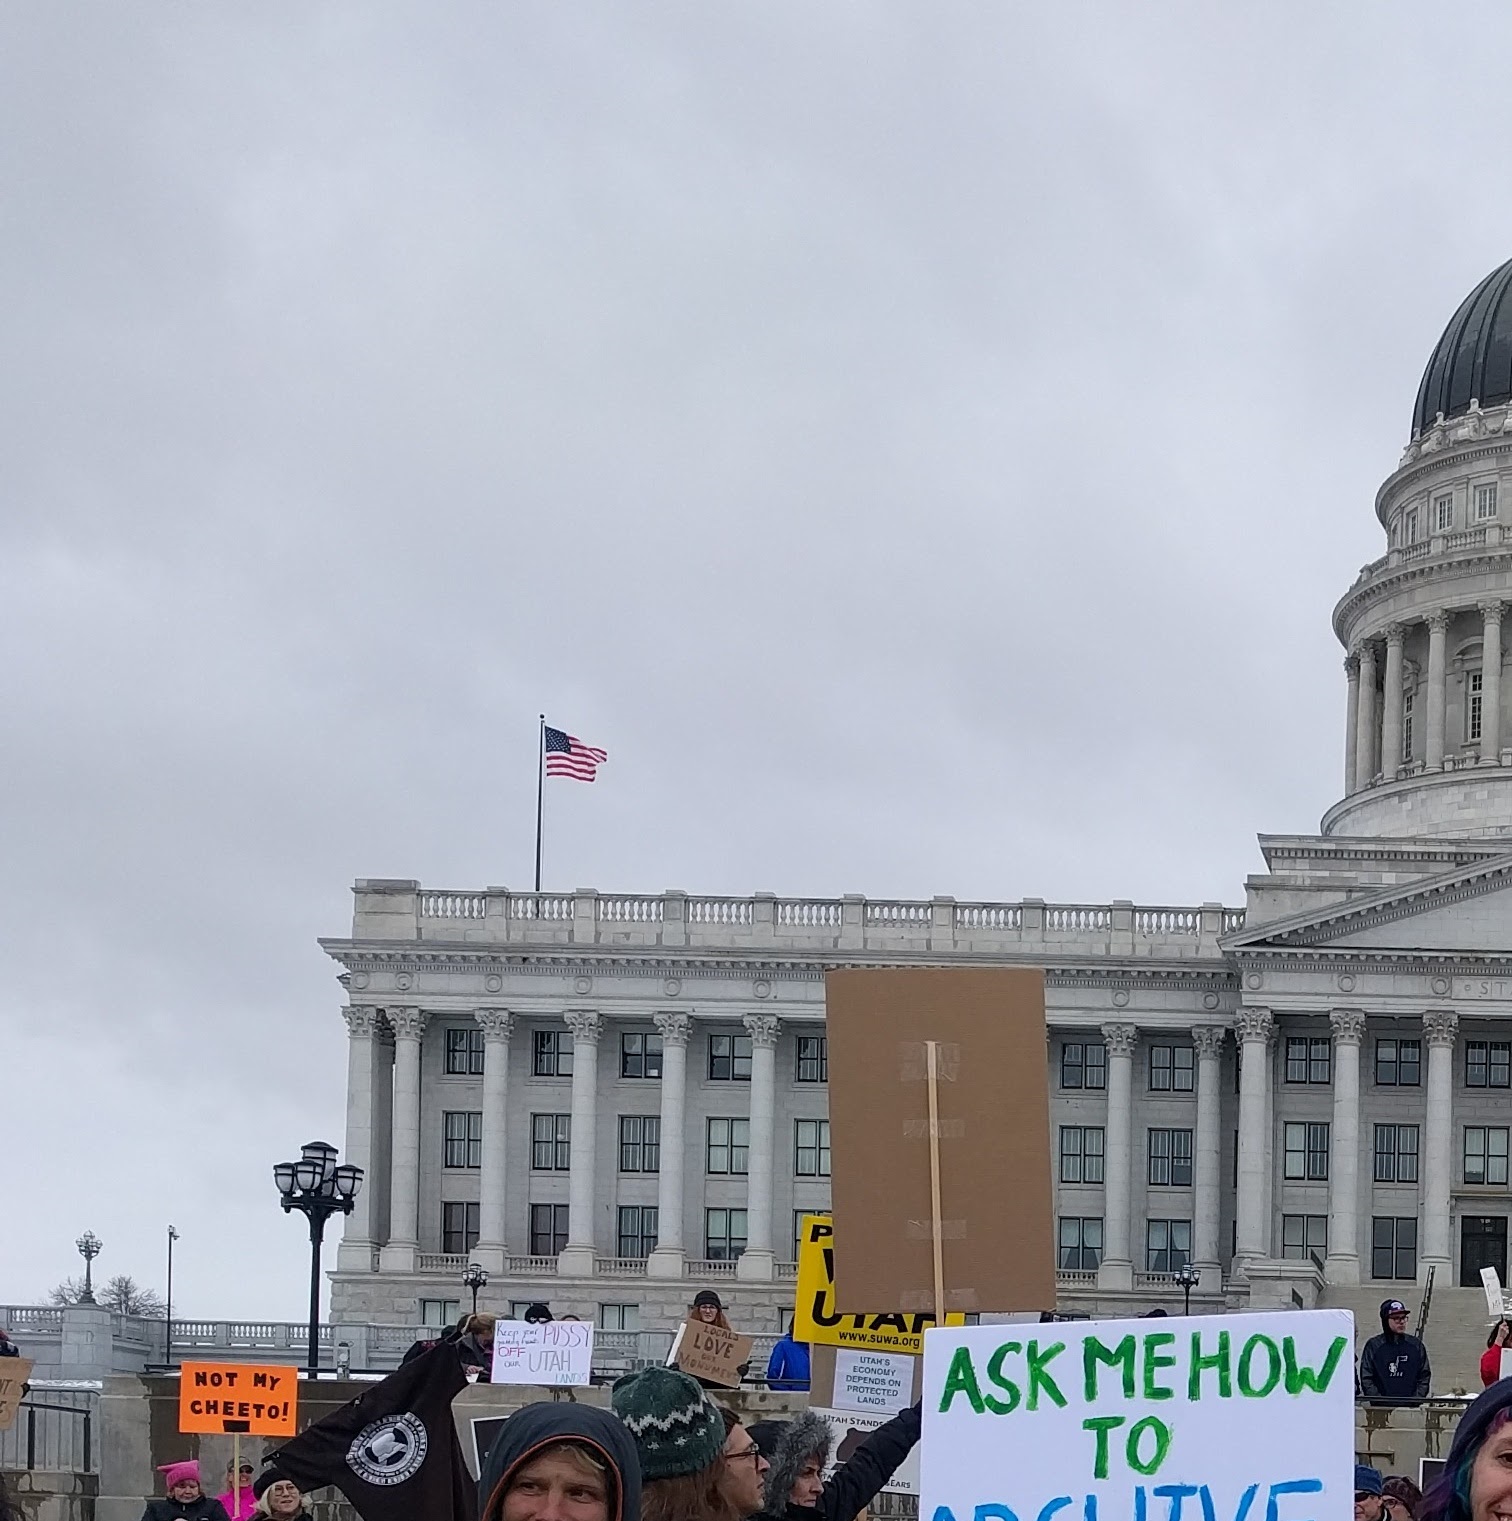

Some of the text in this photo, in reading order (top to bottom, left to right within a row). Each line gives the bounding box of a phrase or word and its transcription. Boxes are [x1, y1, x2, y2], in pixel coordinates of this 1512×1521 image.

[497, 1322, 519, 1340] Keep
[543, 1325, 591, 1347] PUSSY
[704, 1325, 739, 1341] LOCALS
[839, 1332, 920, 1349] www.suwa.org
[498, 1346, 526, 1357] OFF
[694, 1333, 734, 1359] LOVE
[529, 1350, 570, 1372] UTAH
[860, 1356, 890, 1366] UTAH'S
[853, 1366, 896, 1376] ECONOMY
[938, 1330, 1348, 1415] ASK ME HOW
[195, 1372, 281, 1391] NOT MY
[846, 1375, 886, 1386] DEPENDS
[847, 1385, 899, 1397] PROTECTED
[857, 1396, 886, 1405] LANDS
[190, 1400, 289, 1422] CHEETO!
[823, 1415, 847, 1423] UTAH
[1082, 1415, 1174, 1479] TO
